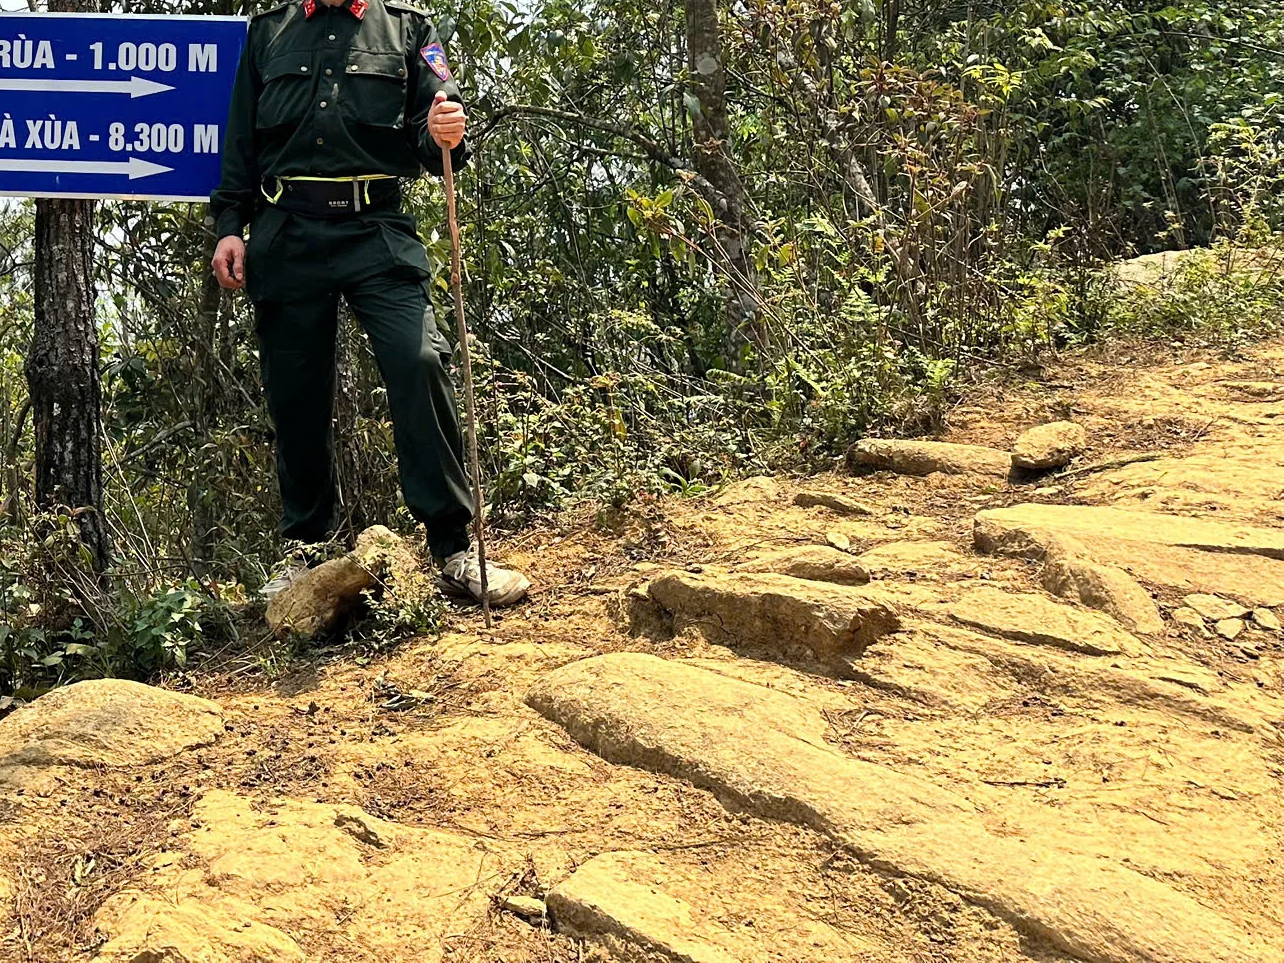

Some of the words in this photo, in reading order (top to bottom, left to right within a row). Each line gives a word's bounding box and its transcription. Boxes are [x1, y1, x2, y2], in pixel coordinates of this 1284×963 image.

[65, 53, 78, 61] -
[89, 41, 177, 72] 1.000
[187, 43, 218, 73] M
[24, 113, 81, 150] XÙA
[89, 134, 100, 142] -
[108, 122, 185, 153] 8.300
[193, 123, 219, 154] M
